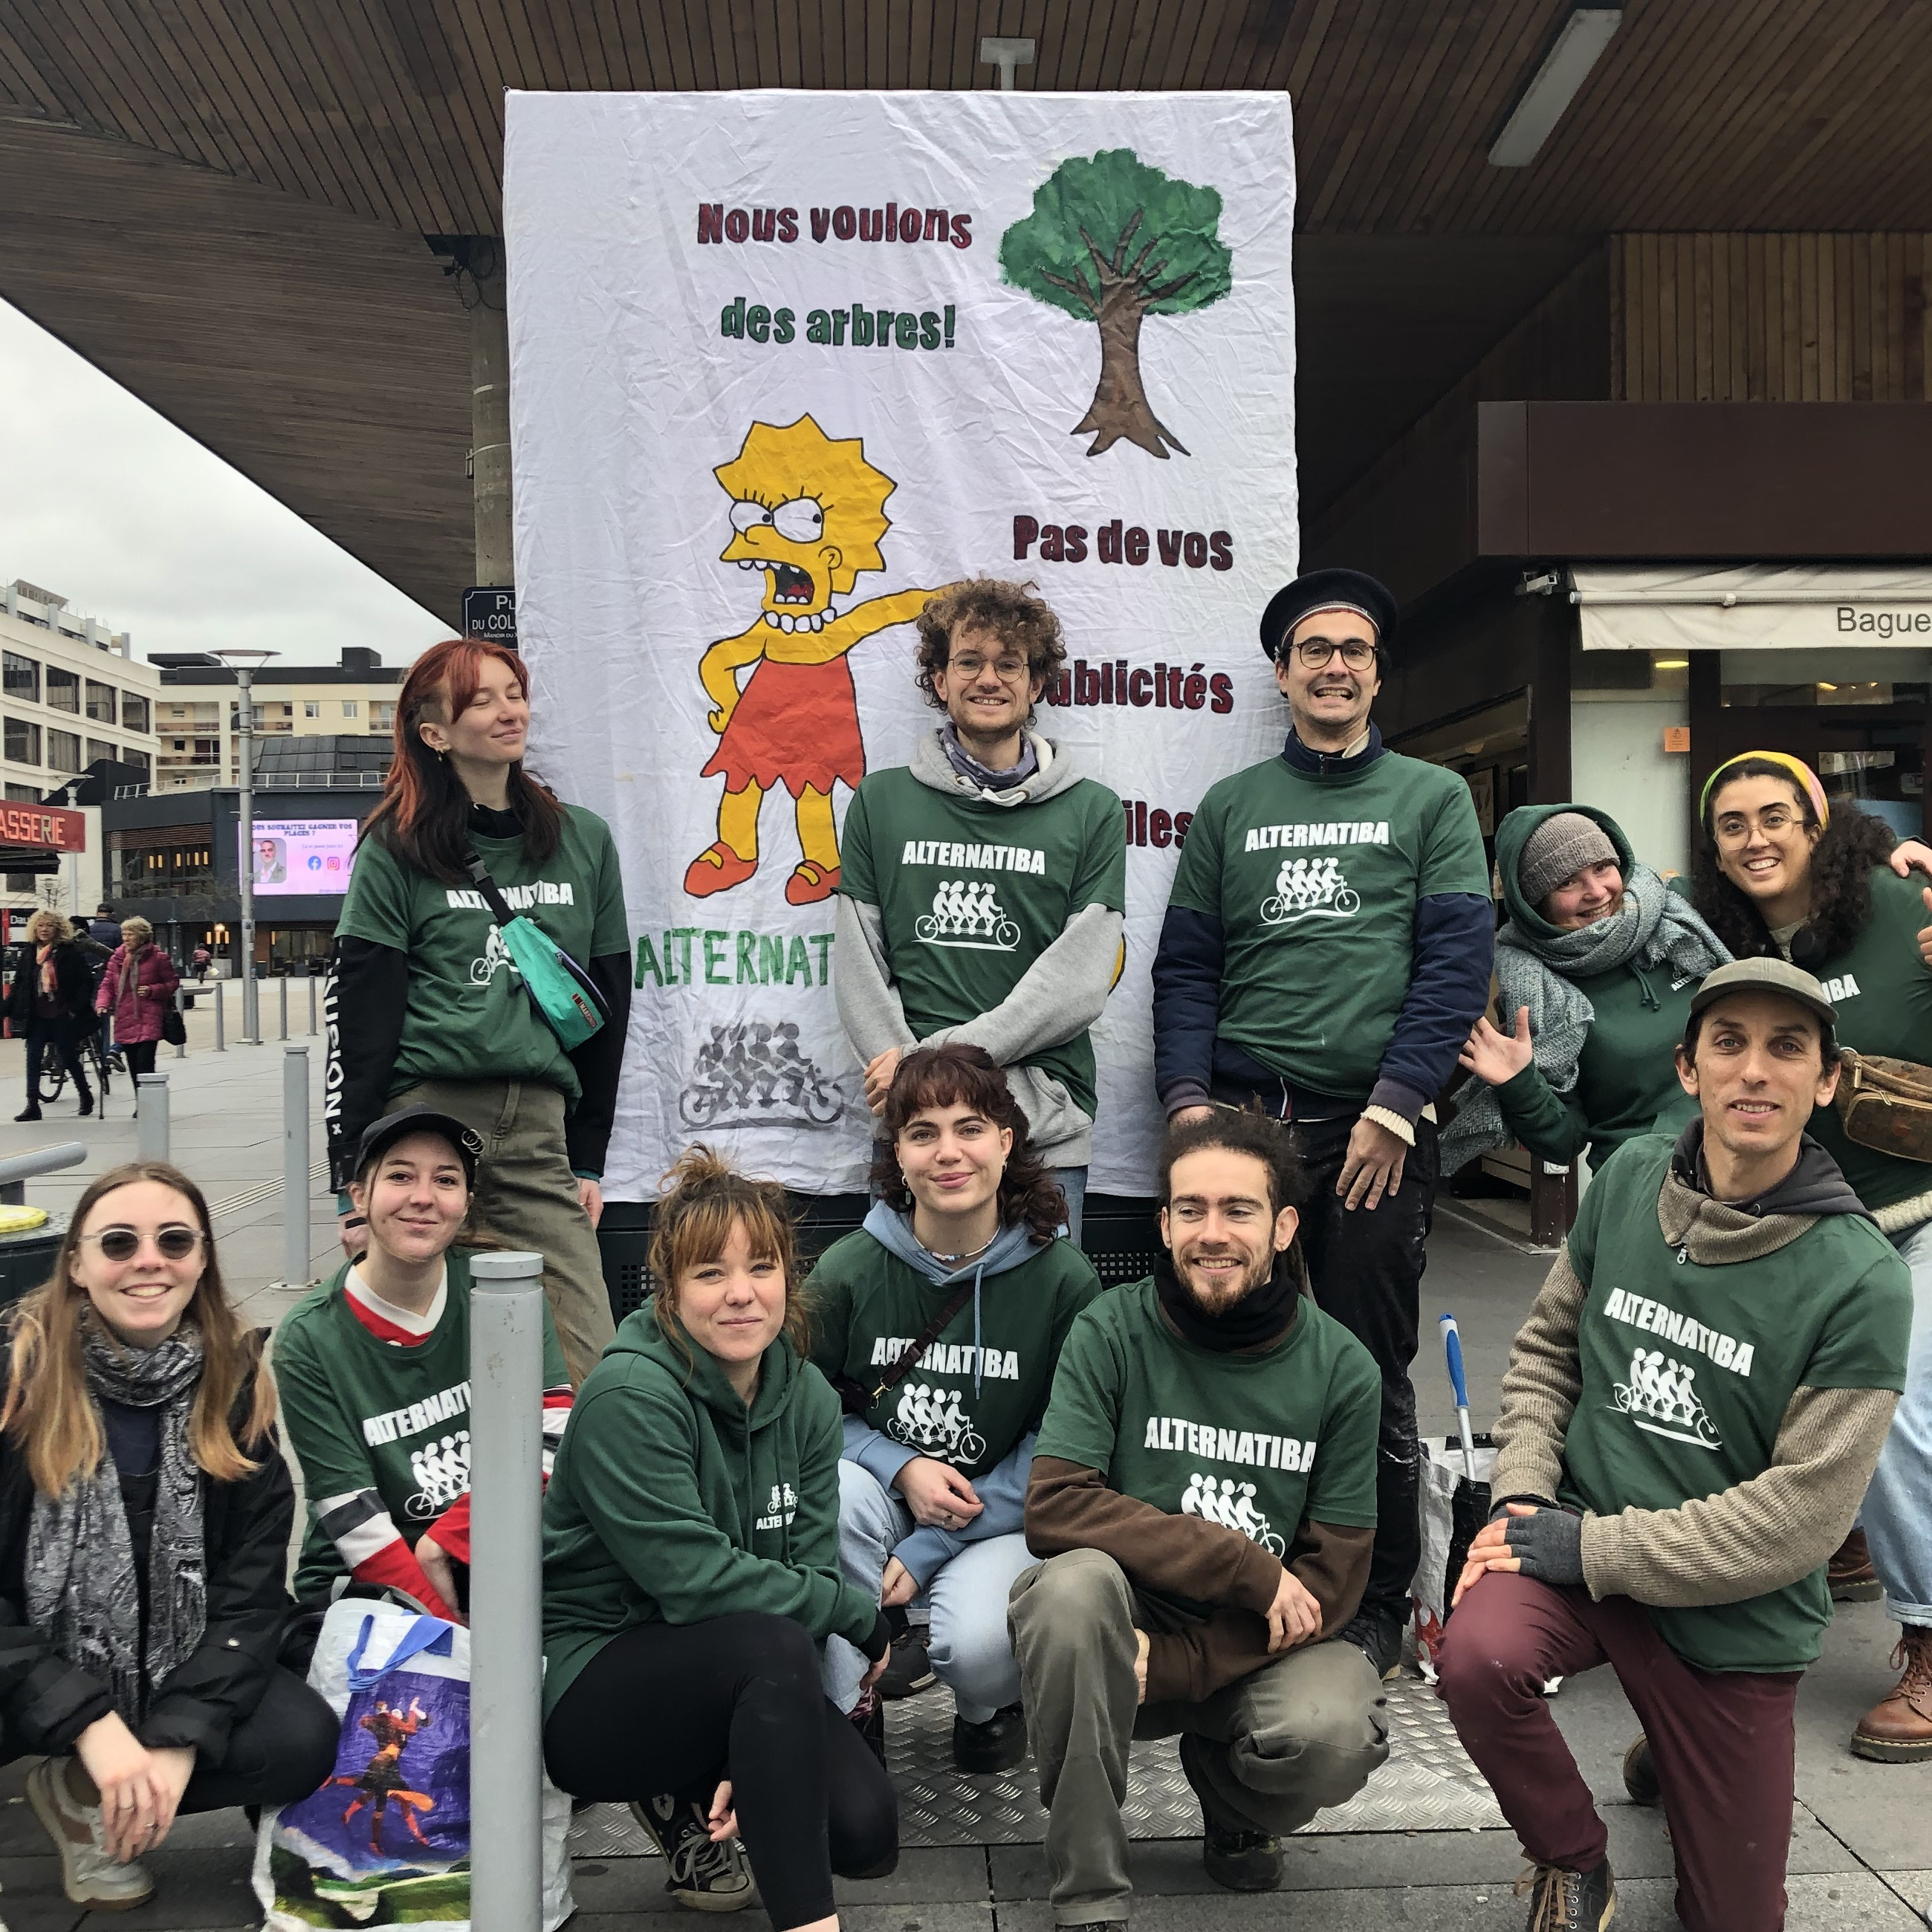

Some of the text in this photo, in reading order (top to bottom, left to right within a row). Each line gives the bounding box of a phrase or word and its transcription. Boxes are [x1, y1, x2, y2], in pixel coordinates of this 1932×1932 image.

[697, 202, 973, 249] Nous voulons
[721, 296, 956, 350] des arbres!
[1013, 515, 1234, 571] Pas de vos
[1837, 606, 1932, 639] Bague
[1034, 659, 1234, 714] ublicités
[901, 840, 1046, 875] ALTERNATIBA
[1244, 821, 1390, 852] ALTERNATIBA
[1603, 1287, 1755, 1377] ALTERNATIBA
[363, 1379, 472, 1447] ALTERNATI
[1144, 1416, 1317, 1473] ALTERNATIBA
